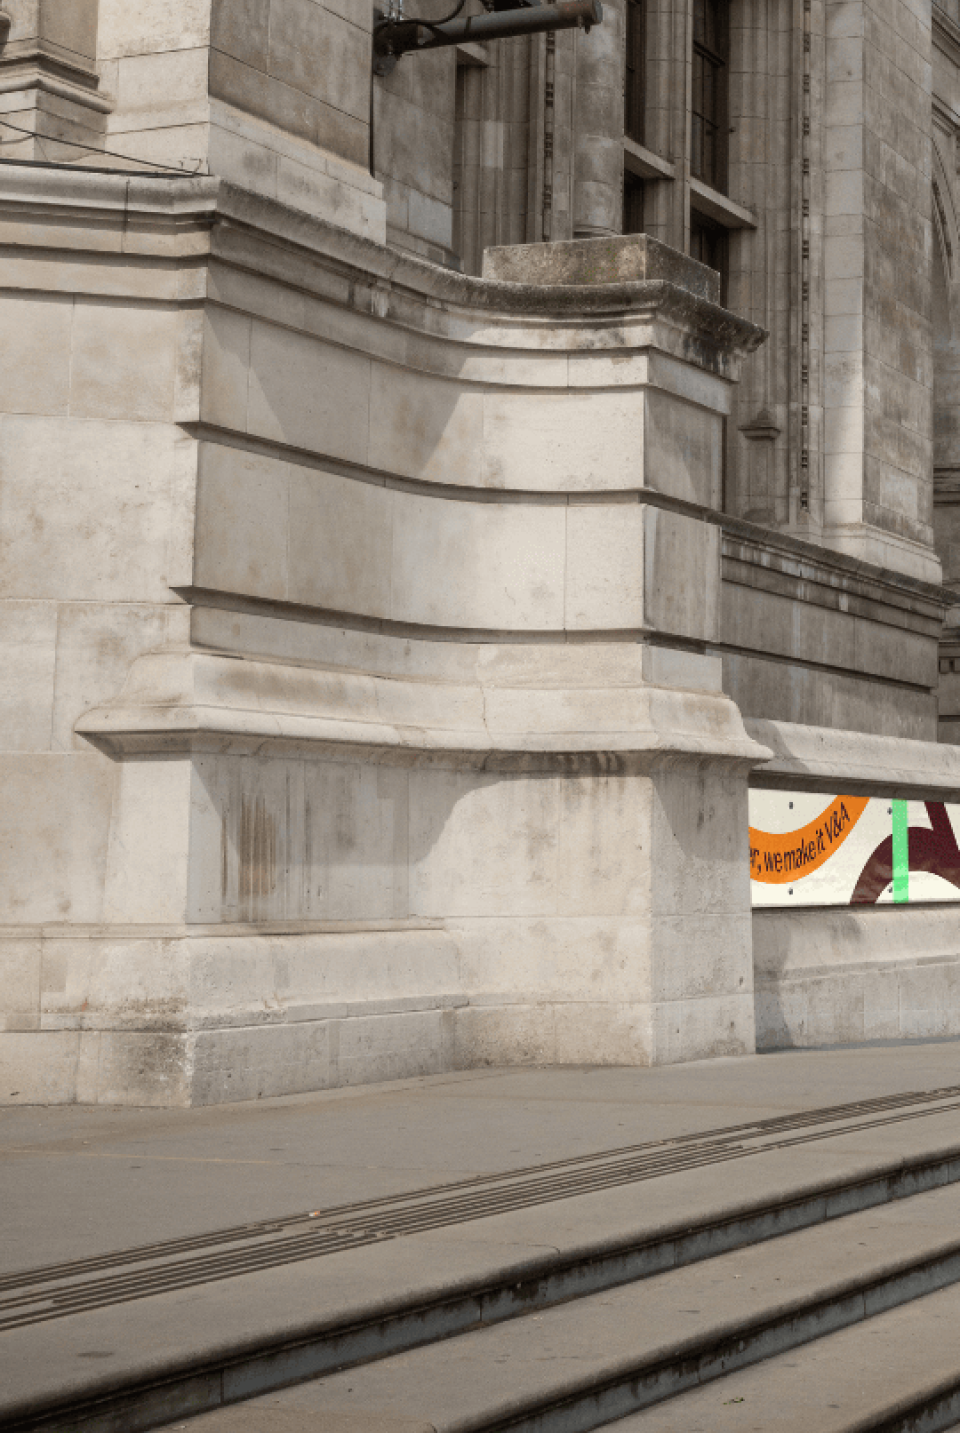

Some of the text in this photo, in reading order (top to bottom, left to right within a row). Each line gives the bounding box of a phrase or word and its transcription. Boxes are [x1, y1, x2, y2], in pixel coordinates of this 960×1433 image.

[763, 851, 783, 873] we
[783, 837, 816, 872] make
[815, 828, 826, 855] it
[823, 801, 850, 844] V&A
